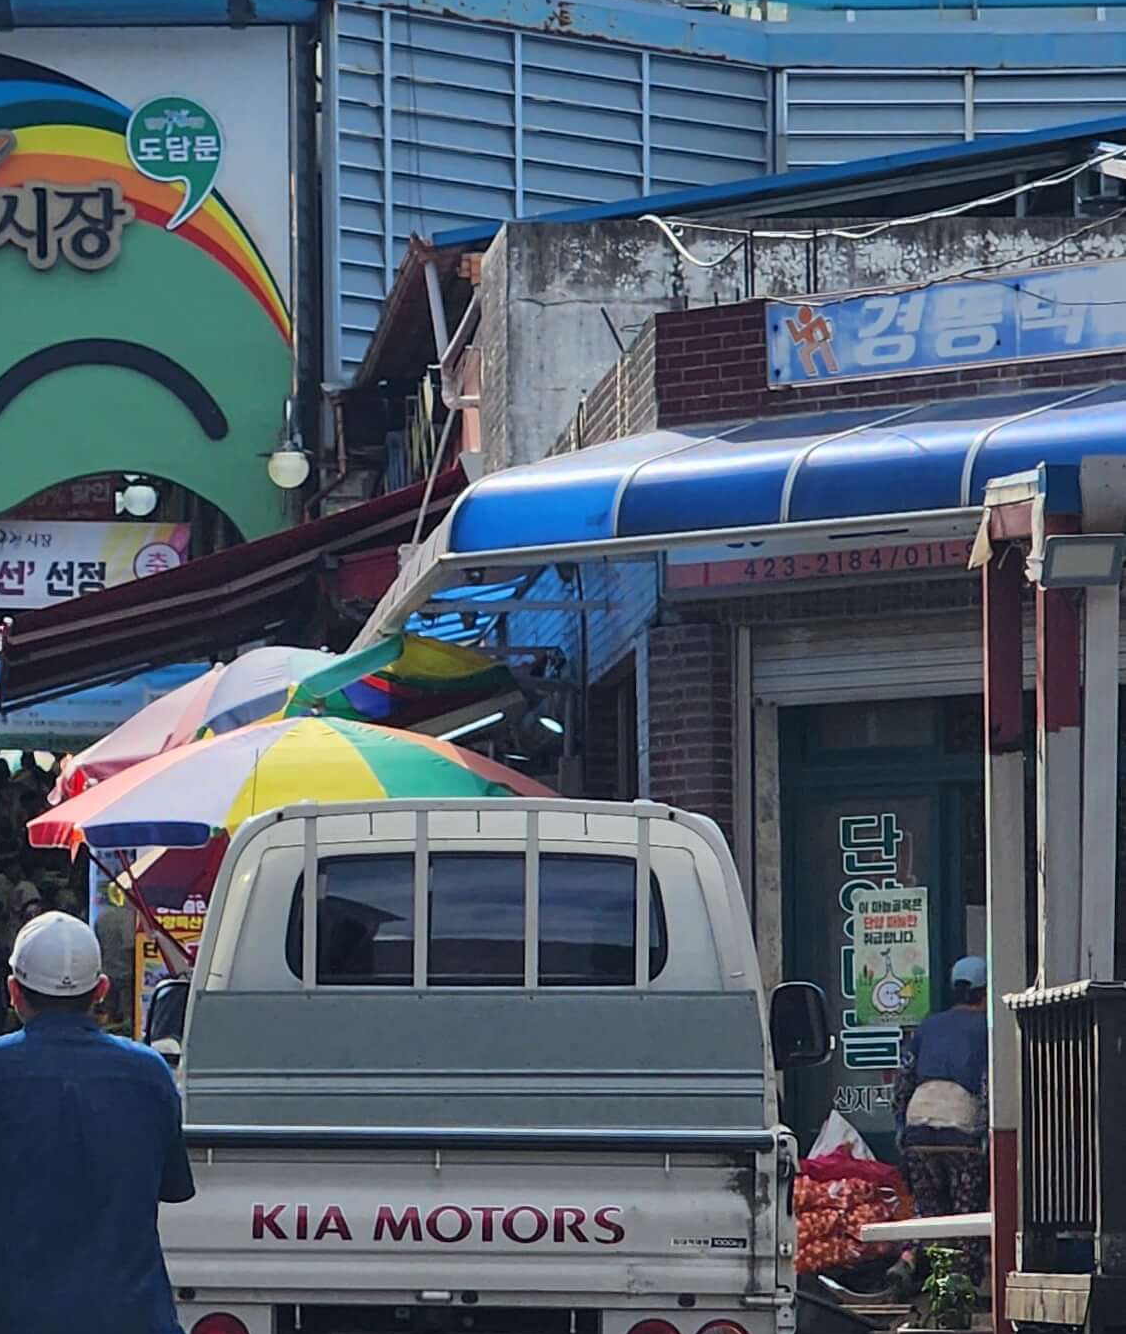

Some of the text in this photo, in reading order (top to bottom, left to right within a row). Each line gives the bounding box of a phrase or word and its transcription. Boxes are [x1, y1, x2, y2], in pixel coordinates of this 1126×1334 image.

[137, 135, 219, 162] 도담문
[45, 561, 107, 597] 선정
[859, 901, 869, 914] 이
[251, 1203, 626, 1245] KIA MOTORS
